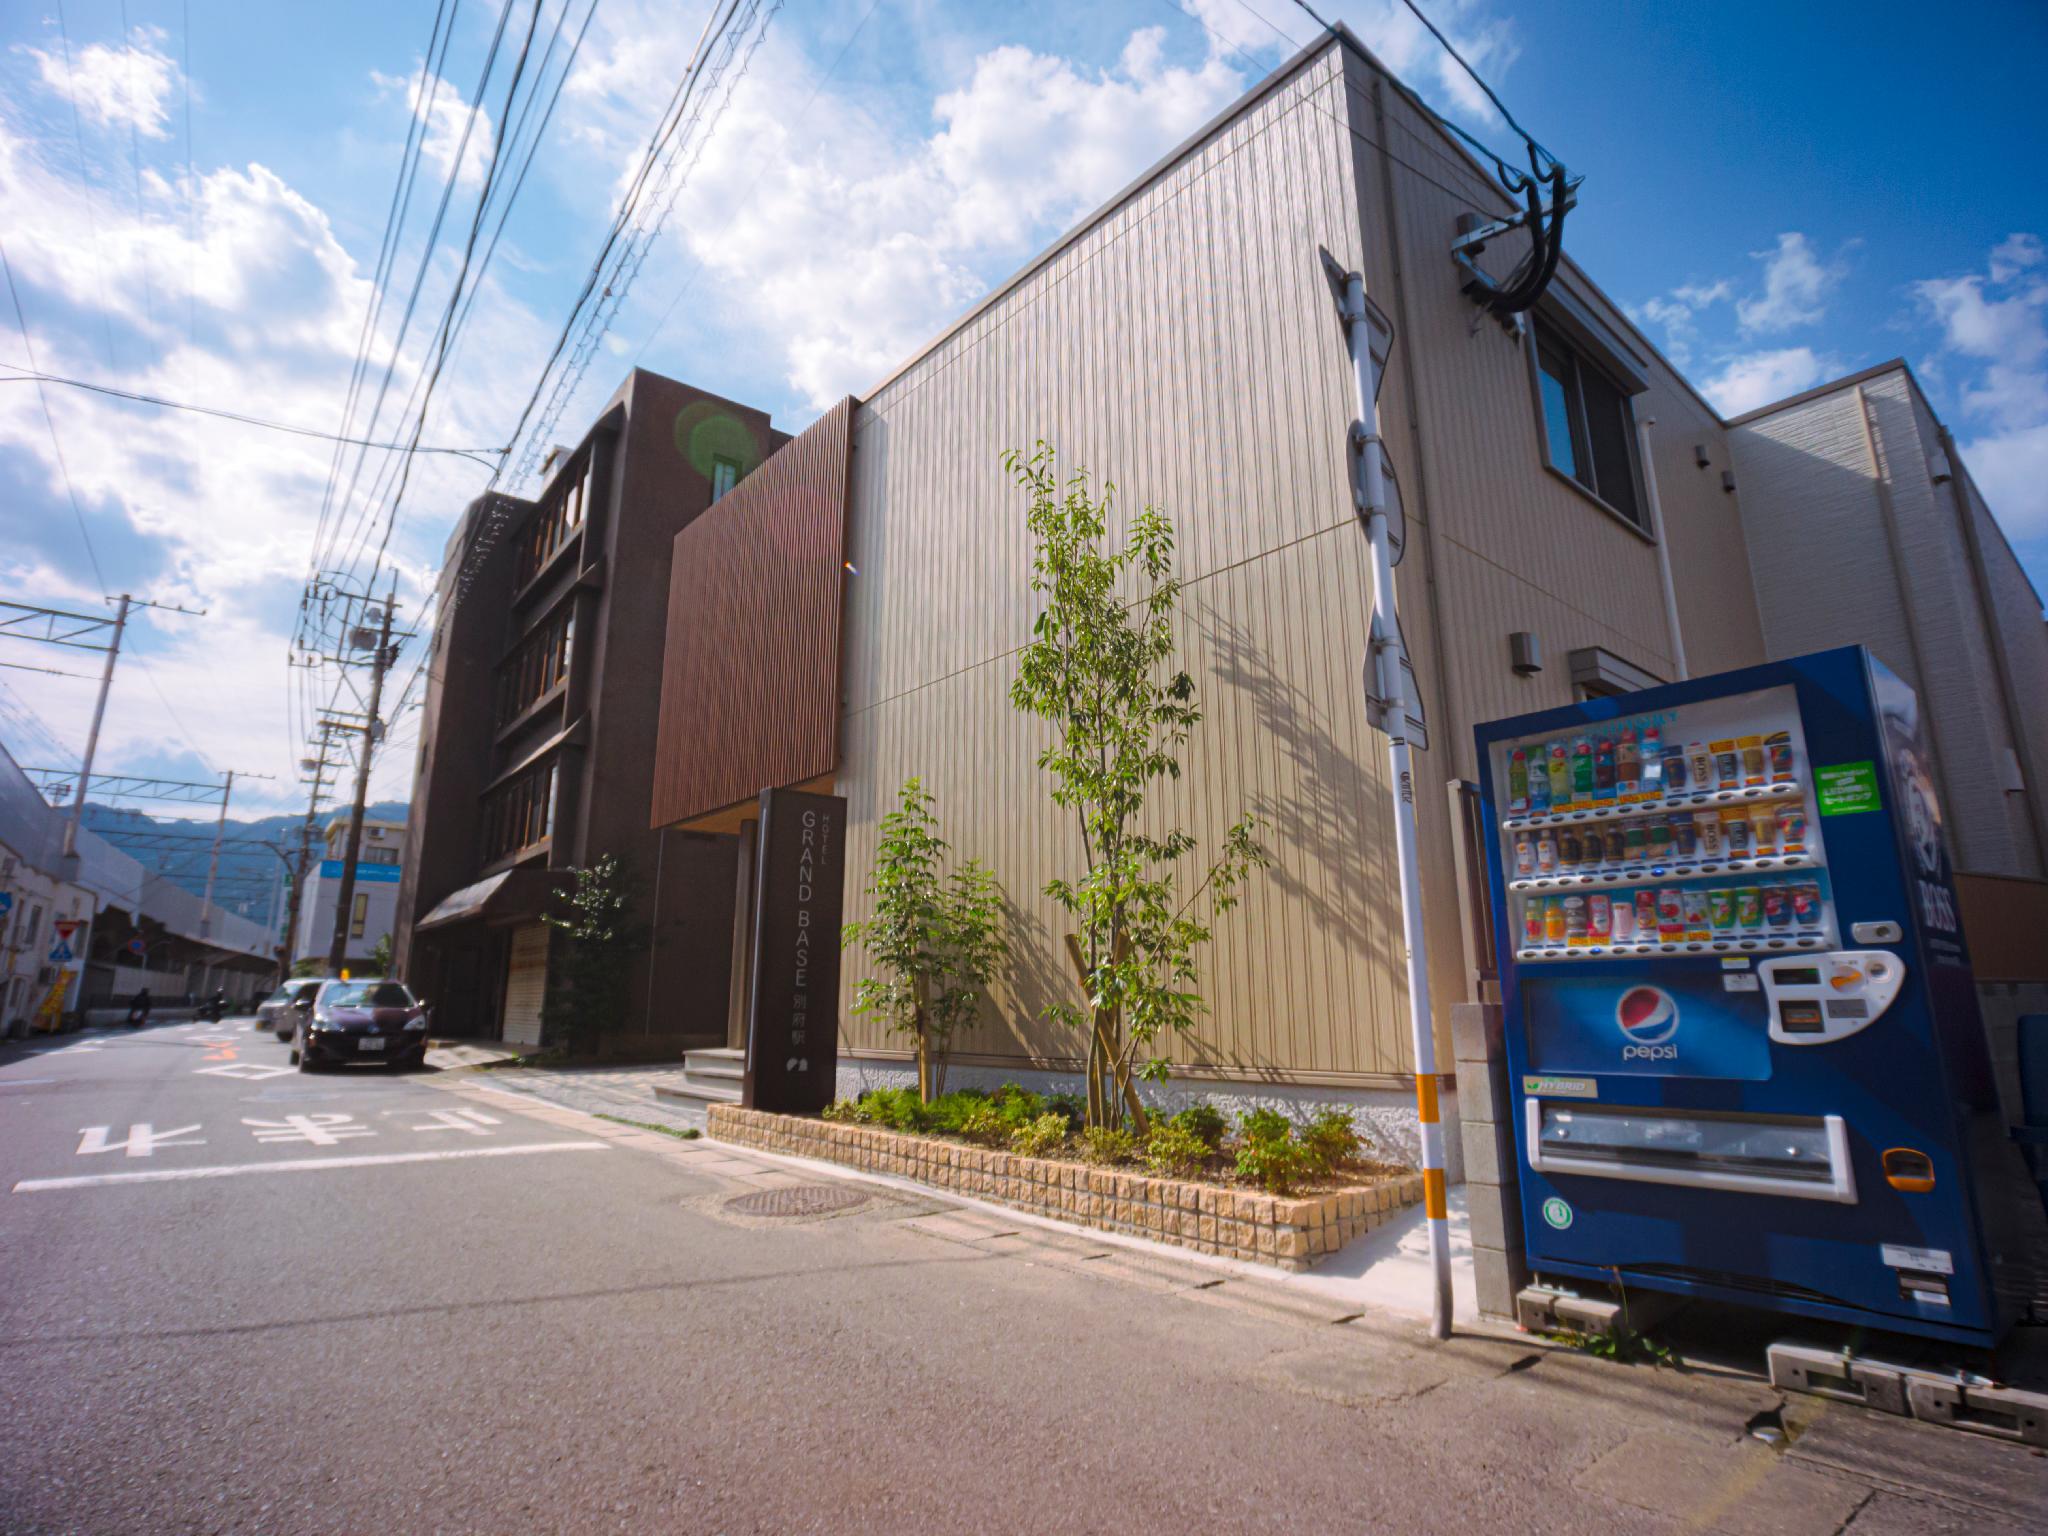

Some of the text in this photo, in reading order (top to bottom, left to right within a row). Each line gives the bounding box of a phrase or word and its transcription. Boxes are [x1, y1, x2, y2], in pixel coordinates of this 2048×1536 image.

[821, 815, 830, 866] HOTEL
[795, 810, 816, 988] GRAND BASE
[1919, 880, 1956, 932] BOSS
[791, 993, 807, 1047] 別府駅
[1622, 1044, 1679, 1062] pepsi
